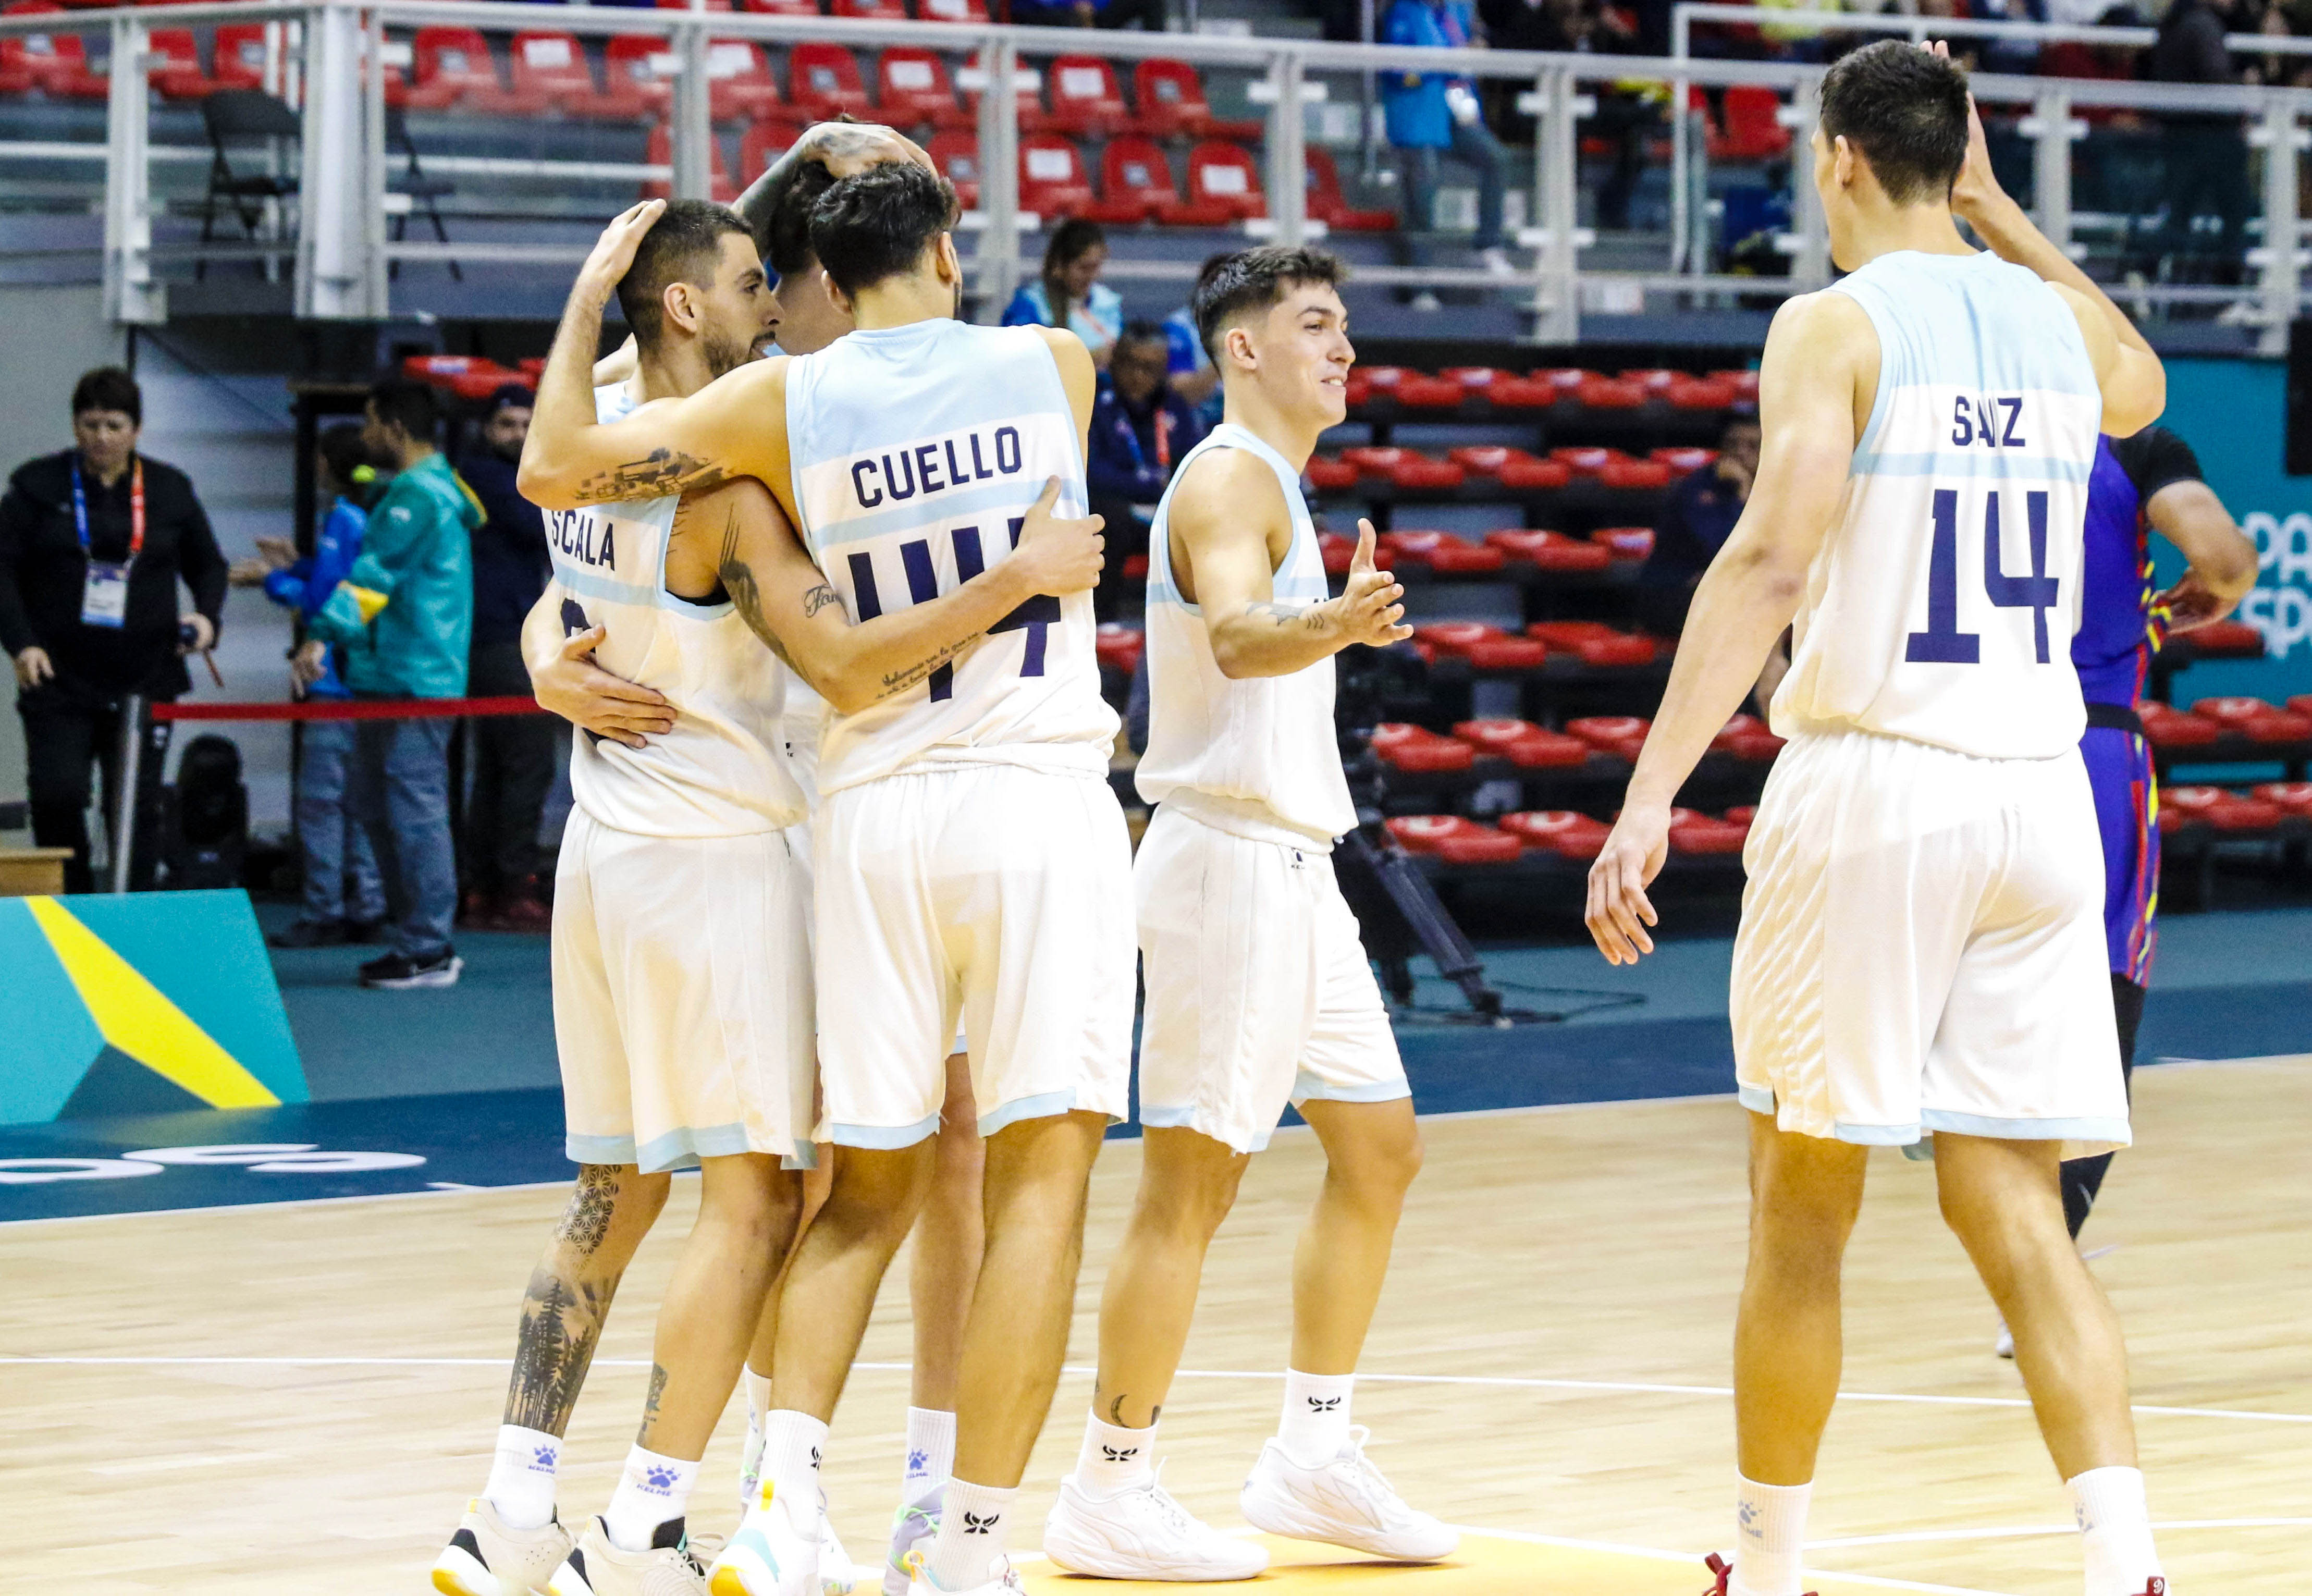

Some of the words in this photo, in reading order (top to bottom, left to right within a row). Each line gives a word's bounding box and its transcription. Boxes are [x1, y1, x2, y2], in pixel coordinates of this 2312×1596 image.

[851, 426, 1022, 508] CUELLO
[551, 509, 615, 571] SCALA
[1905, 489, 2060, 664] 14
[637, 1483, 671, 1496] KELME
